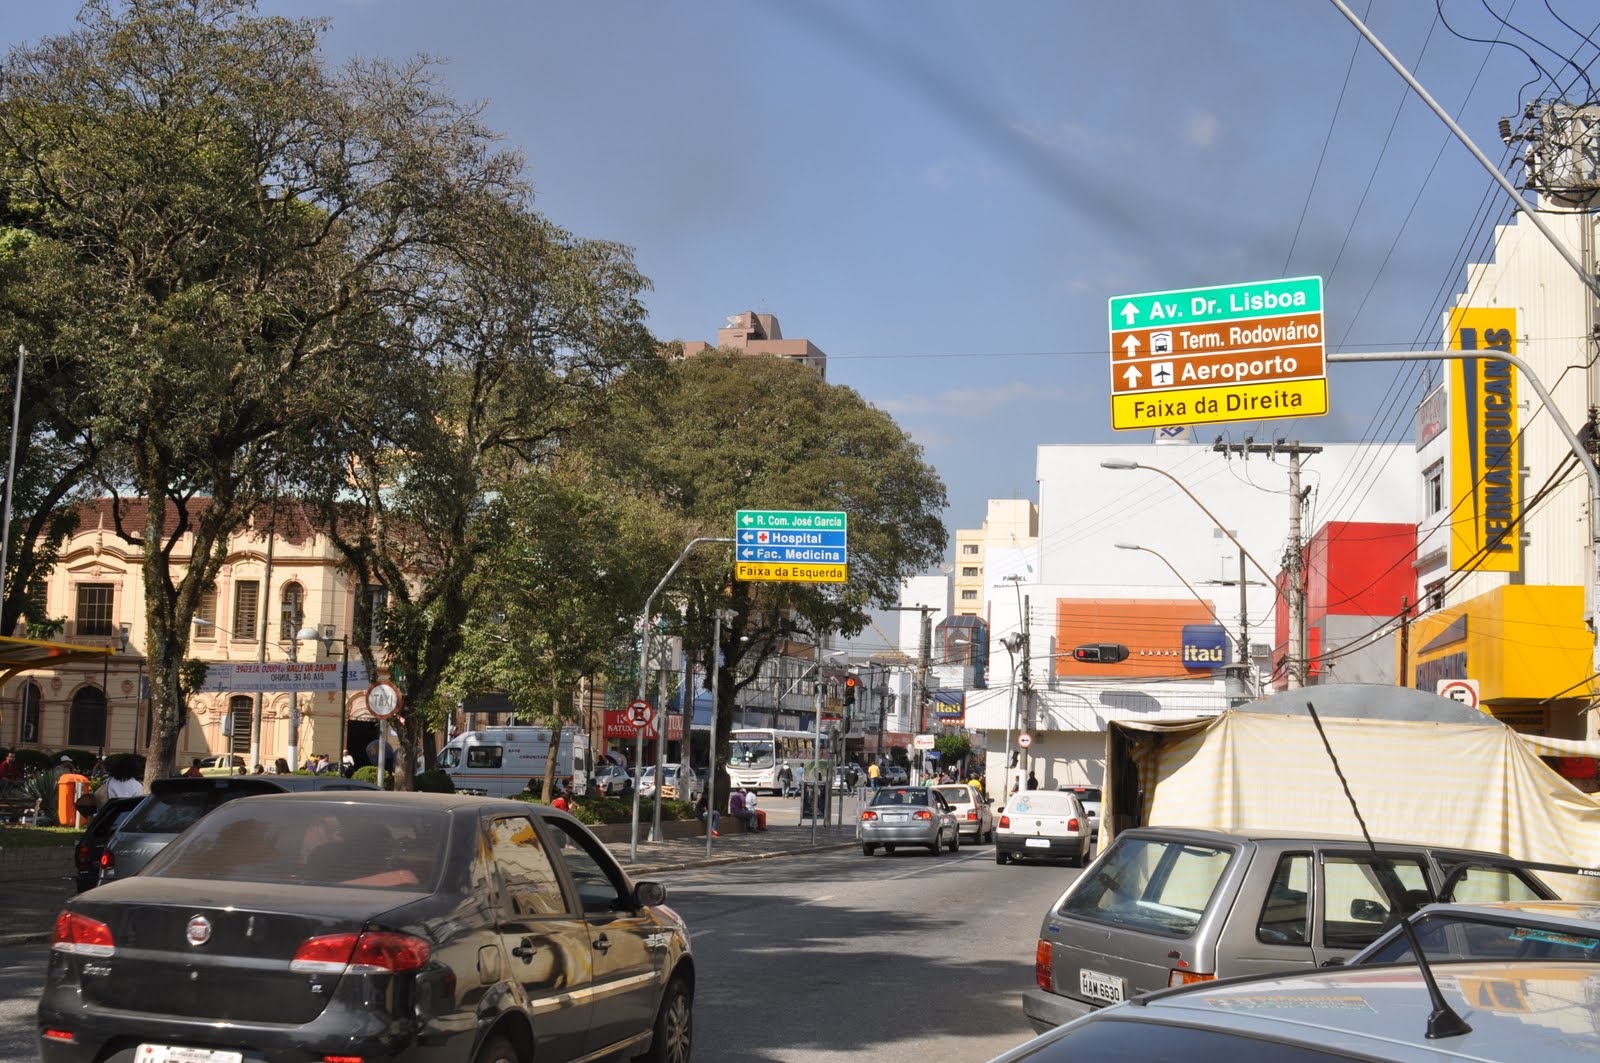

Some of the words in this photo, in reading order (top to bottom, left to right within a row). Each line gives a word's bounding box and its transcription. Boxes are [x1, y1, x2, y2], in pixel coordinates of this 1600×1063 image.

[1149, 302, 1183, 320] Av.
[1191, 297, 1222, 316] Dr.
[1230, 290, 1306, 312] Lisboa
[1180, 331, 1224, 349] Term.
[1230, 321, 1319, 345] Rodoviário
[1181, 357, 1298, 381] Aeroporto
[1134, 401, 1187, 419] Faixa
[1195, 396, 1218, 414] da
[1227, 390, 1302, 412] Direita
[757, 515, 766, 526] R.
[768, 515, 790, 526] Com.
[792, 515, 812, 527] José
[814, 515, 842, 527] Garcia
[772, 532, 821, 545] Hospital
[757, 548, 781, 559] Fac.
[785, 549, 840, 560] Medicina
[740, 566, 770, 576] Faixa
[775, 567, 789, 577] da
[792, 567, 843, 579] Esquerda
[1184, 645, 1223, 662] Itaú
[373, 693, 394, 708] TAXI
[607, 725, 638, 733] KATUXA
